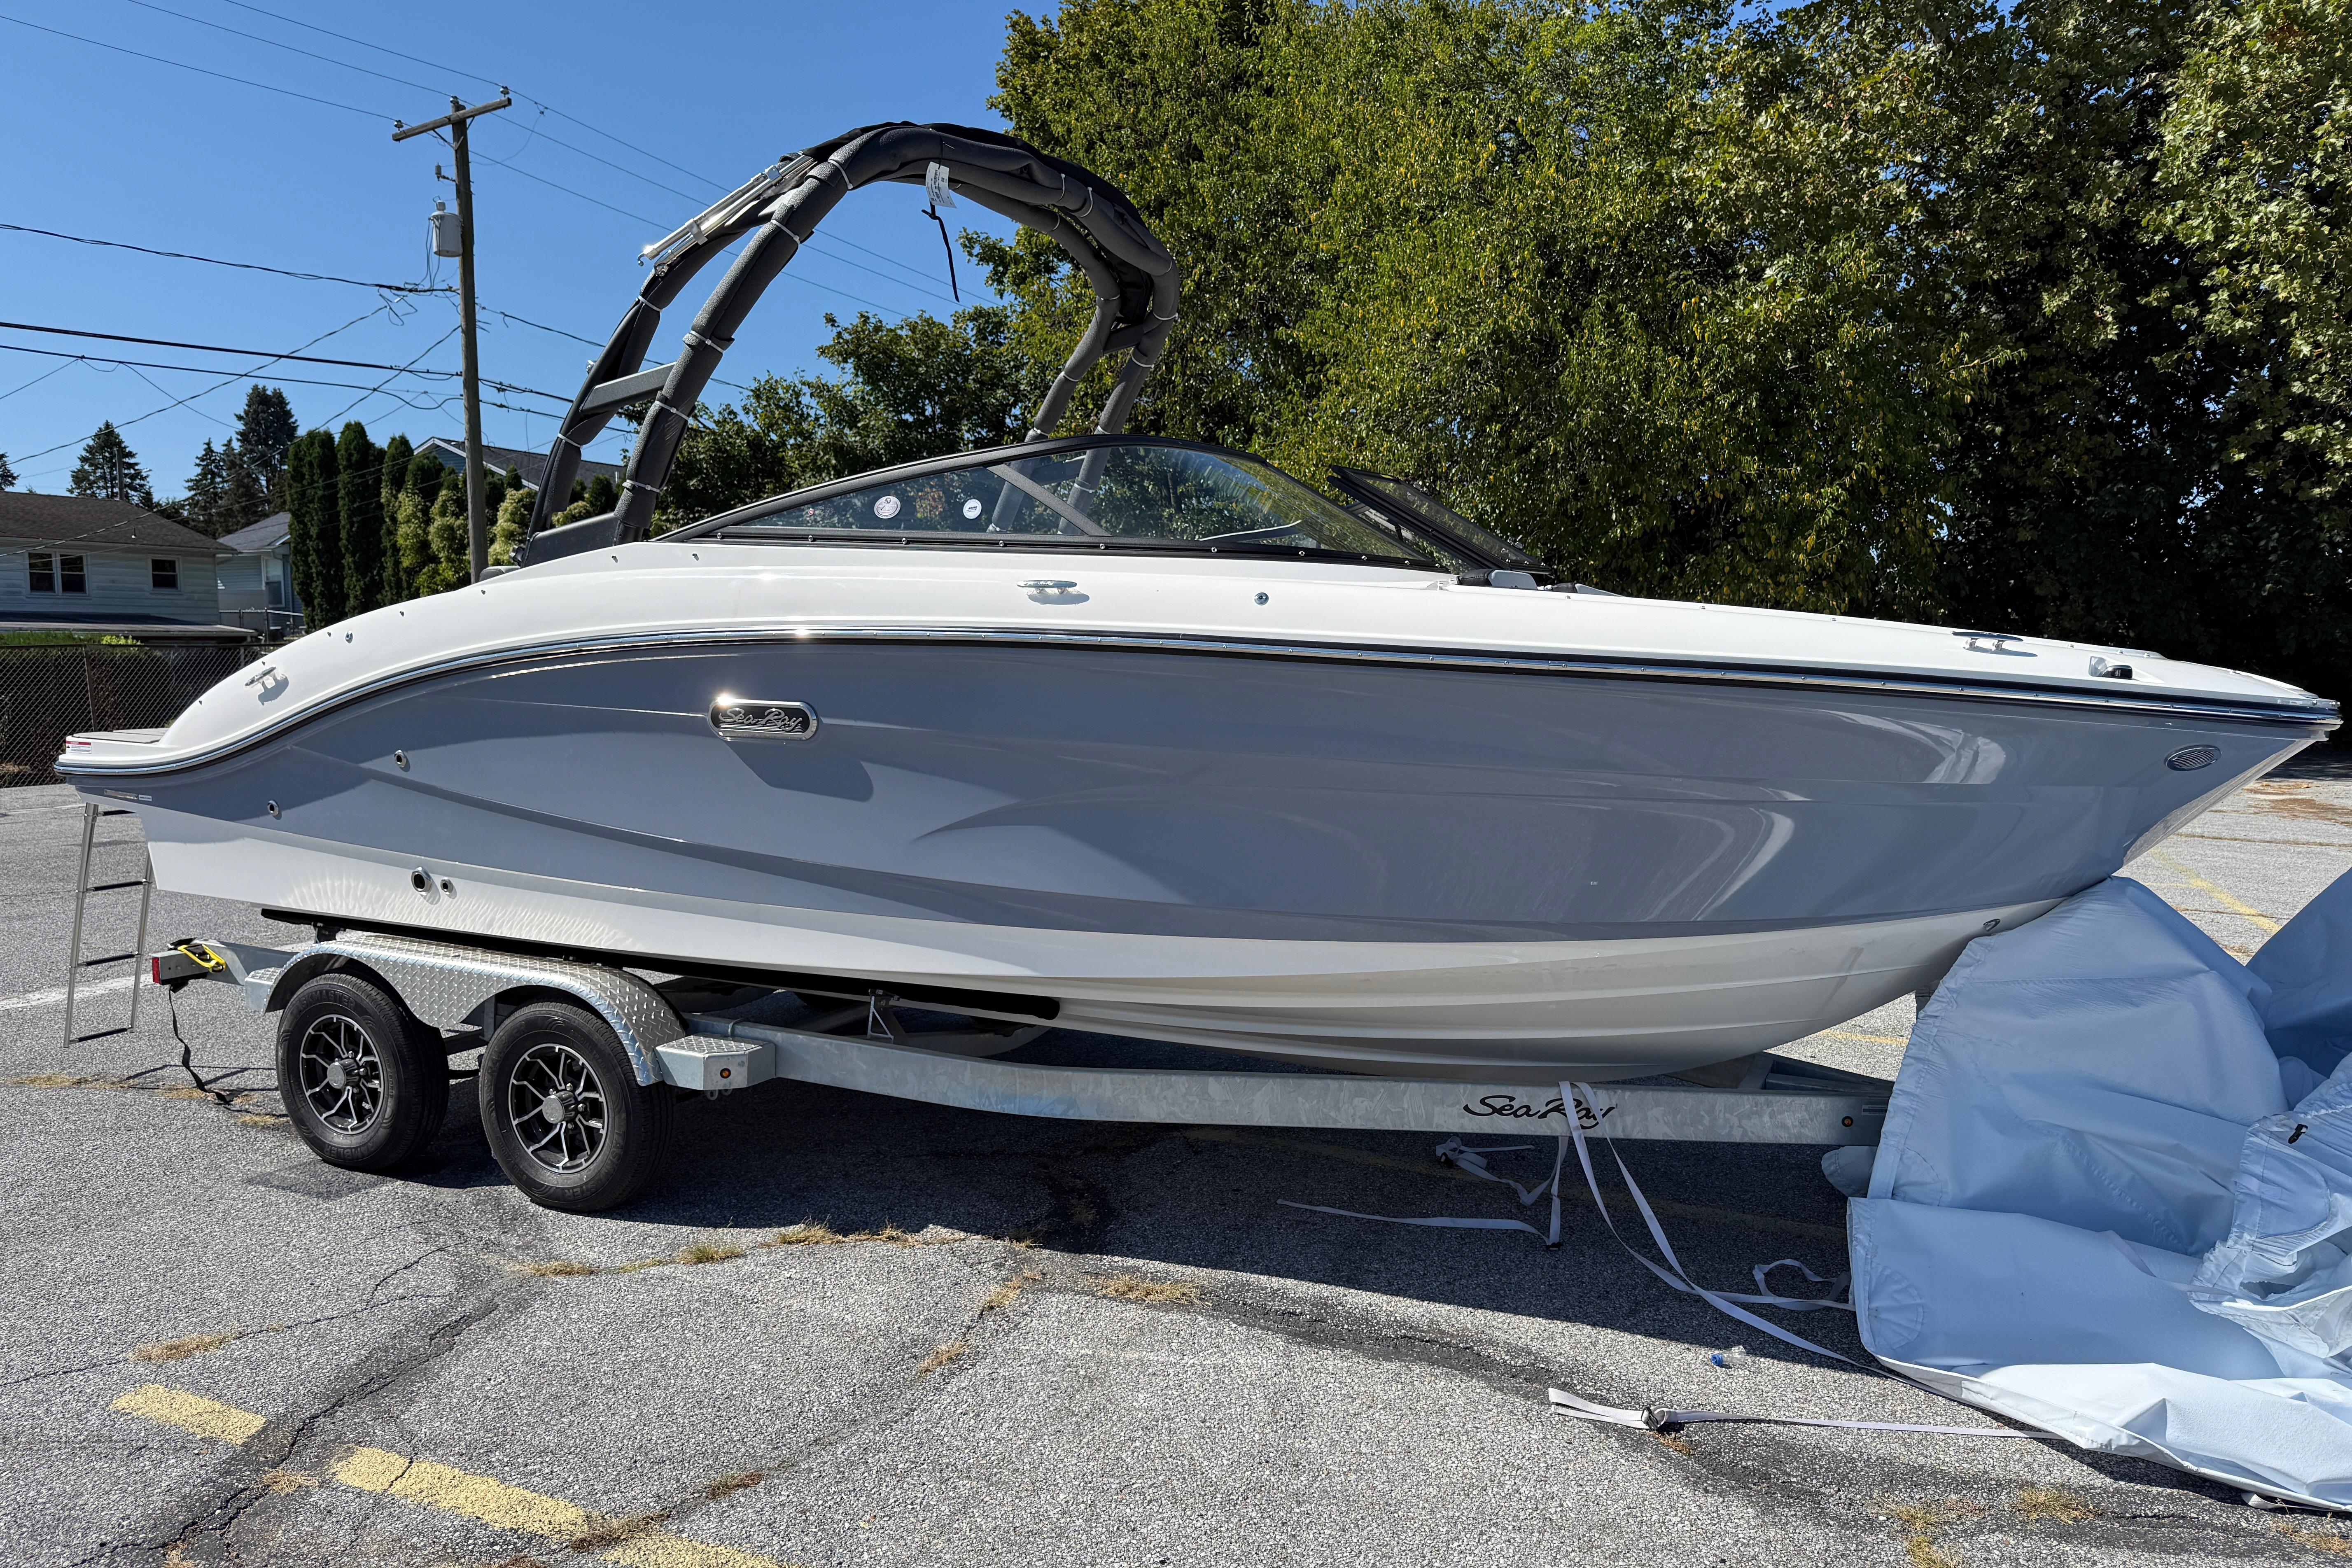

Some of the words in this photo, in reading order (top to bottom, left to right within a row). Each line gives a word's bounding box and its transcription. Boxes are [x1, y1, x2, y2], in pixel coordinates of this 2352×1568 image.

[719, 707, 757, 724] Sea
[761, 708, 803, 731] Ray
[1463, 1095, 1540, 1118] Sea
[1538, 1098, 1615, 1130] Ray
